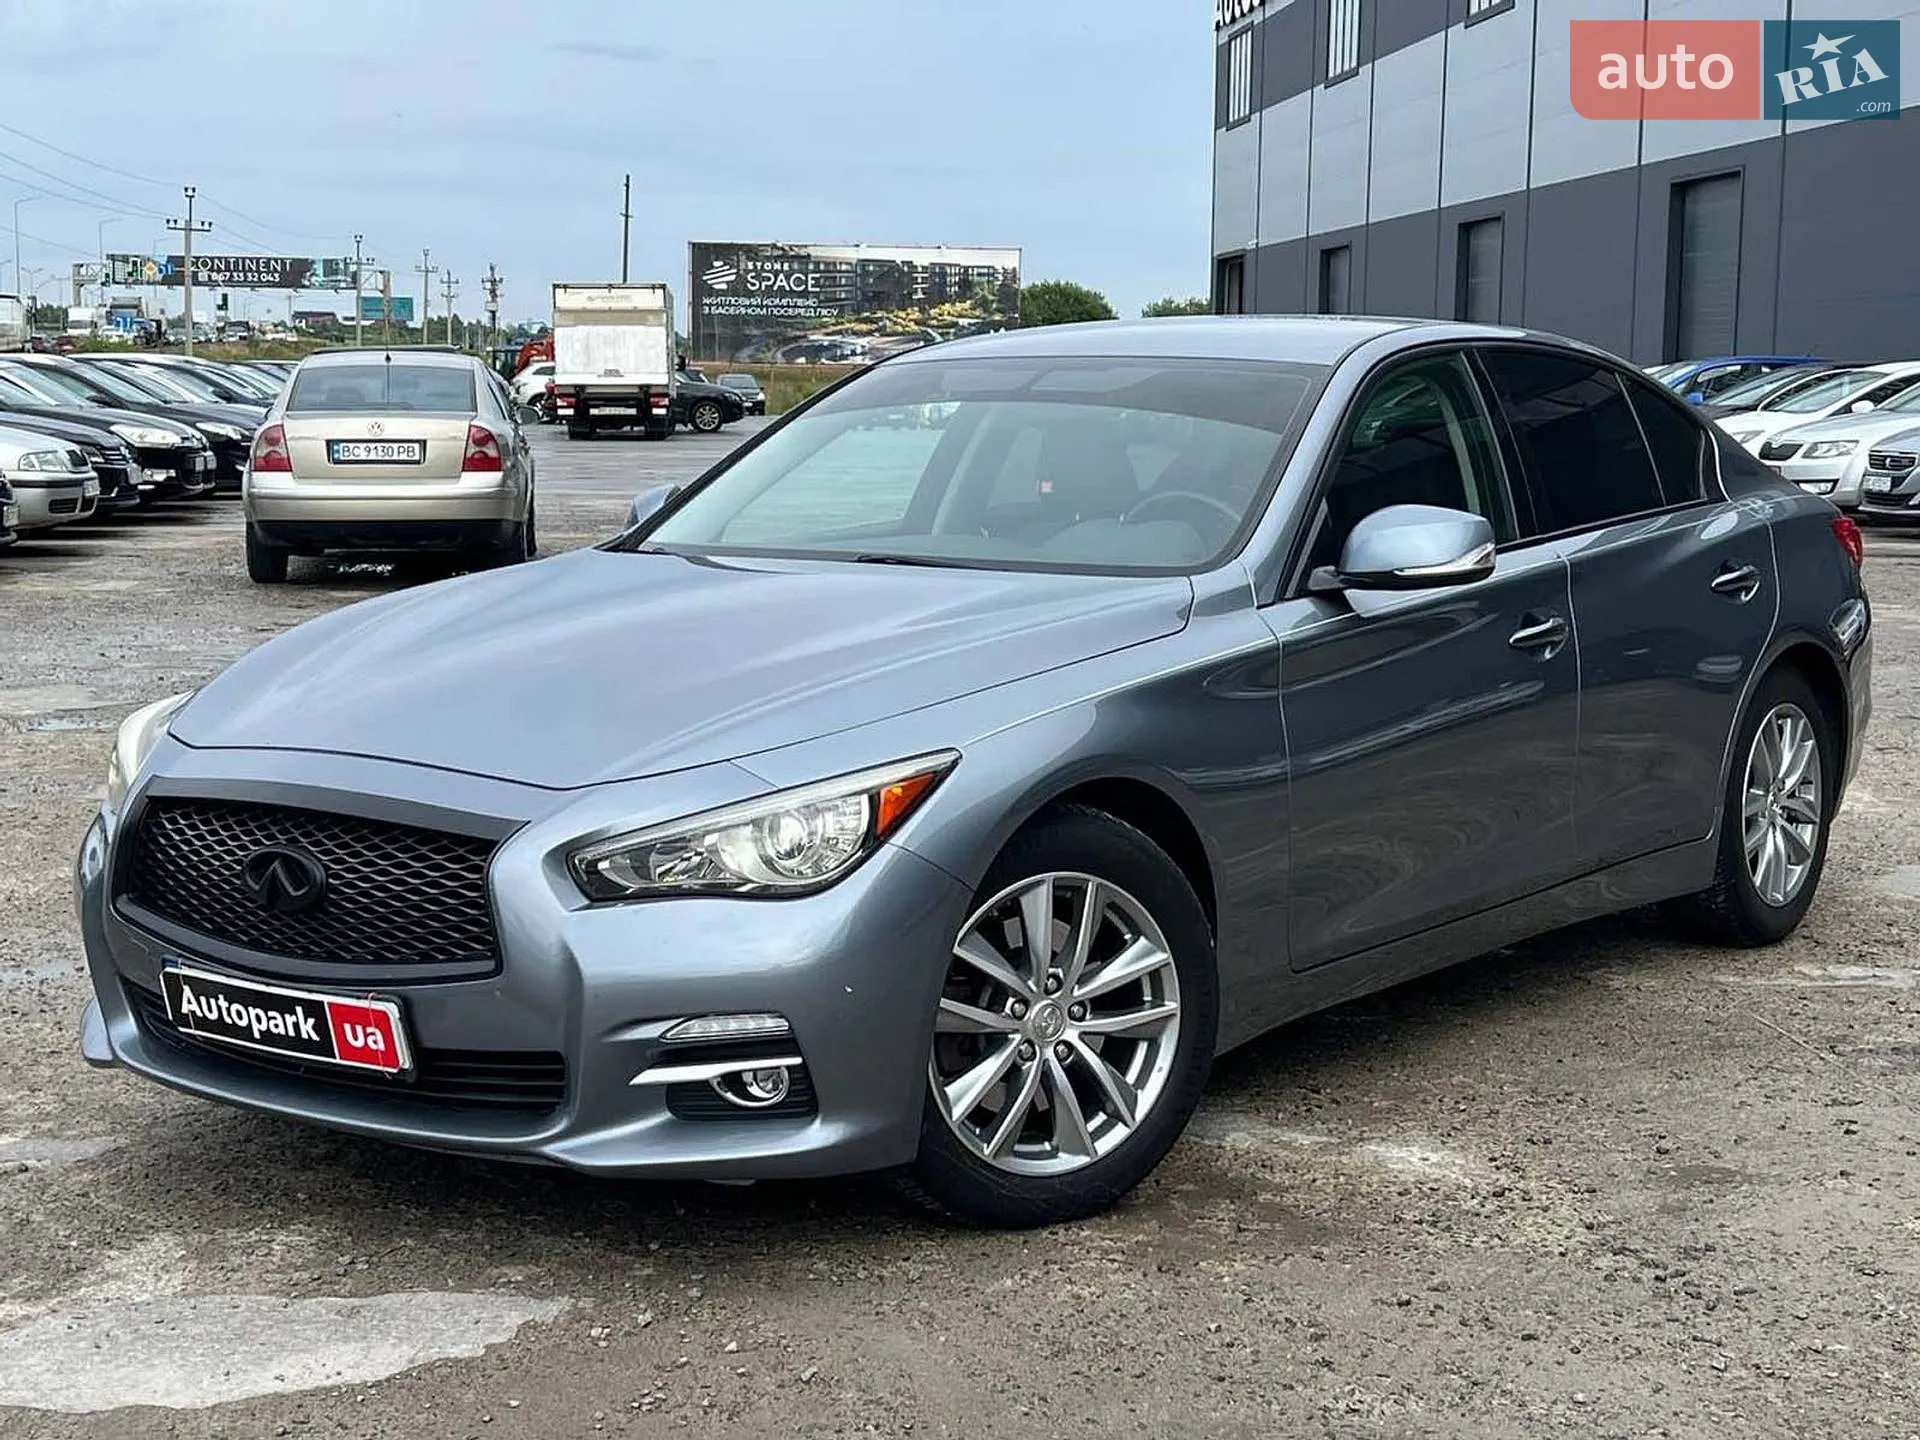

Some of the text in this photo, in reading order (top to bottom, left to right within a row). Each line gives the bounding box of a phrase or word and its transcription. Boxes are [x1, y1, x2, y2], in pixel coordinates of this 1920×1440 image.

[746, 261, 790, 271] STONE
[746, 272, 821, 291] SPACE
[342, 445, 416, 458] BC 9130 PB
[181, 984, 386, 1052] Autopark ua
